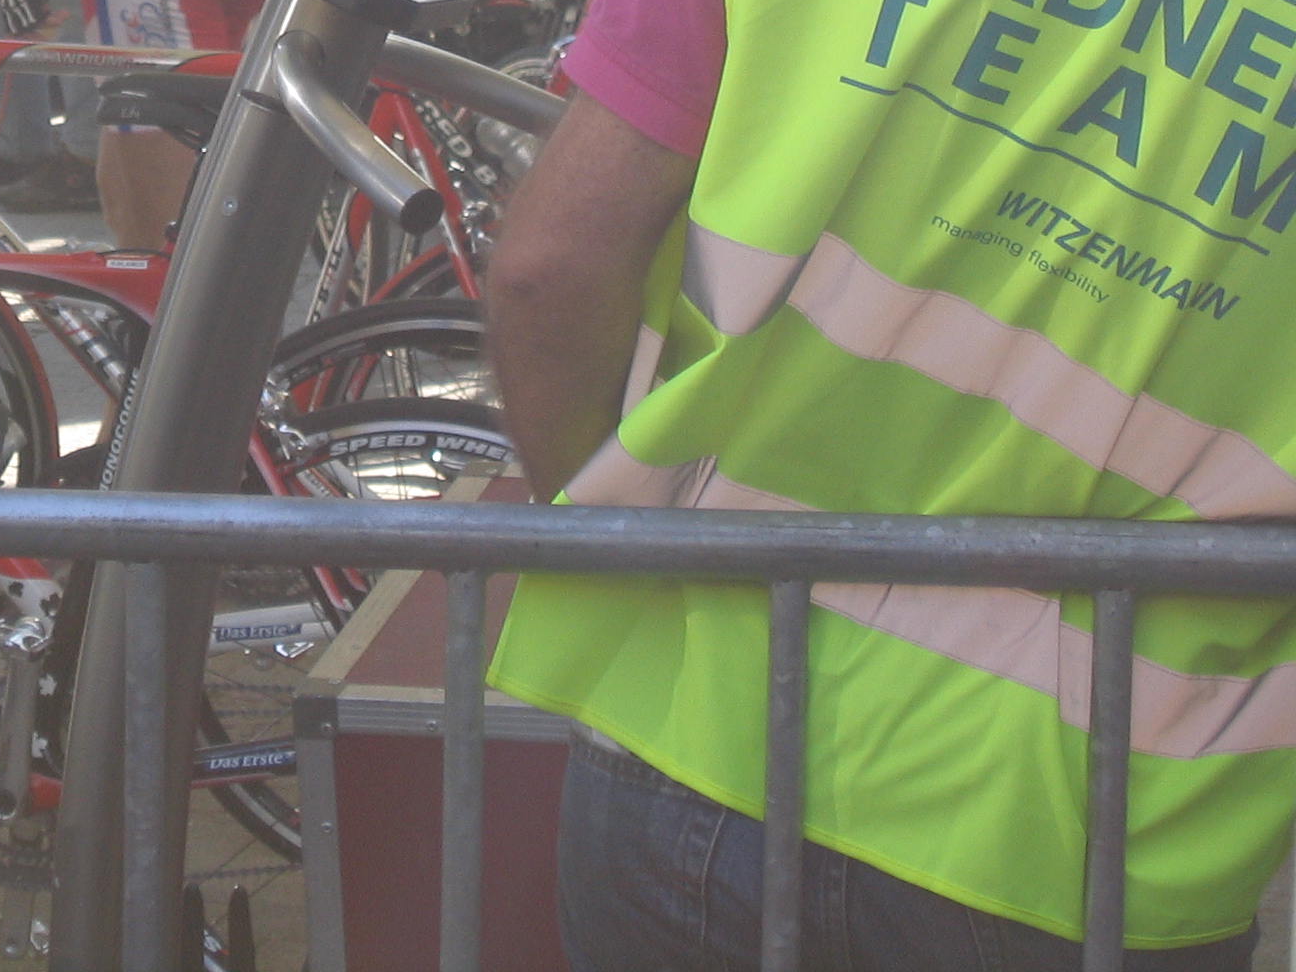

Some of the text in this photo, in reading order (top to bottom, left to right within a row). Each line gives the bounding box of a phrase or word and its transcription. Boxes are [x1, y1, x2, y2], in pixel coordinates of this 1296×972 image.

[931, 214, 1024, 258] managing
[1027, 249, 1111, 303] flexibility
[329, 434, 427, 457] SPEED
[220, 624, 288, 641] Das Erste
[209, 752, 284, 770] Das Erste
